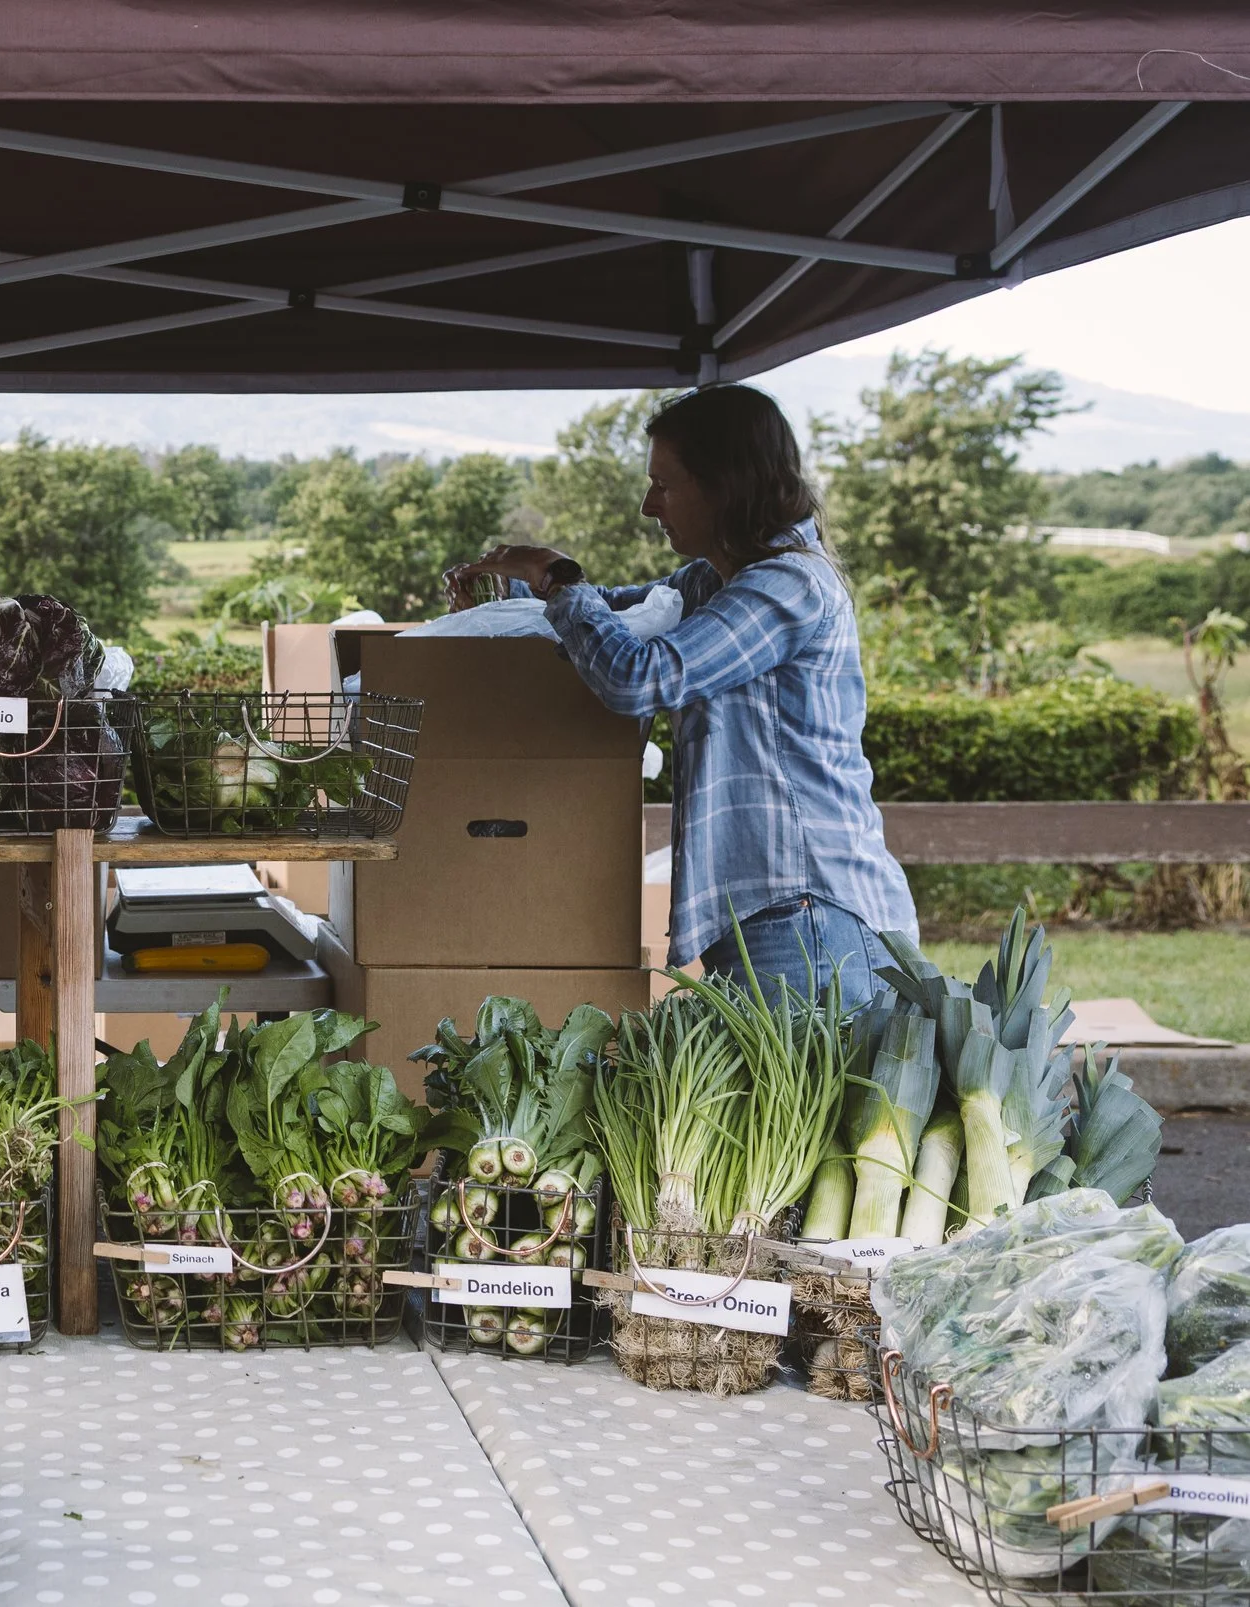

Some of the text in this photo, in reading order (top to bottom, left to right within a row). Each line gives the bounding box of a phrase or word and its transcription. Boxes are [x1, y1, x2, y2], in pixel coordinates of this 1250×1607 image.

[172, 1253, 215, 1264] Spinach
[852, 1247, 886, 1258] Leeks
[467, 1279, 554, 1297] Dandelion
[722, 1296, 778, 1317] Onion
[1170, 1486, 1249, 1505] Broccolini
